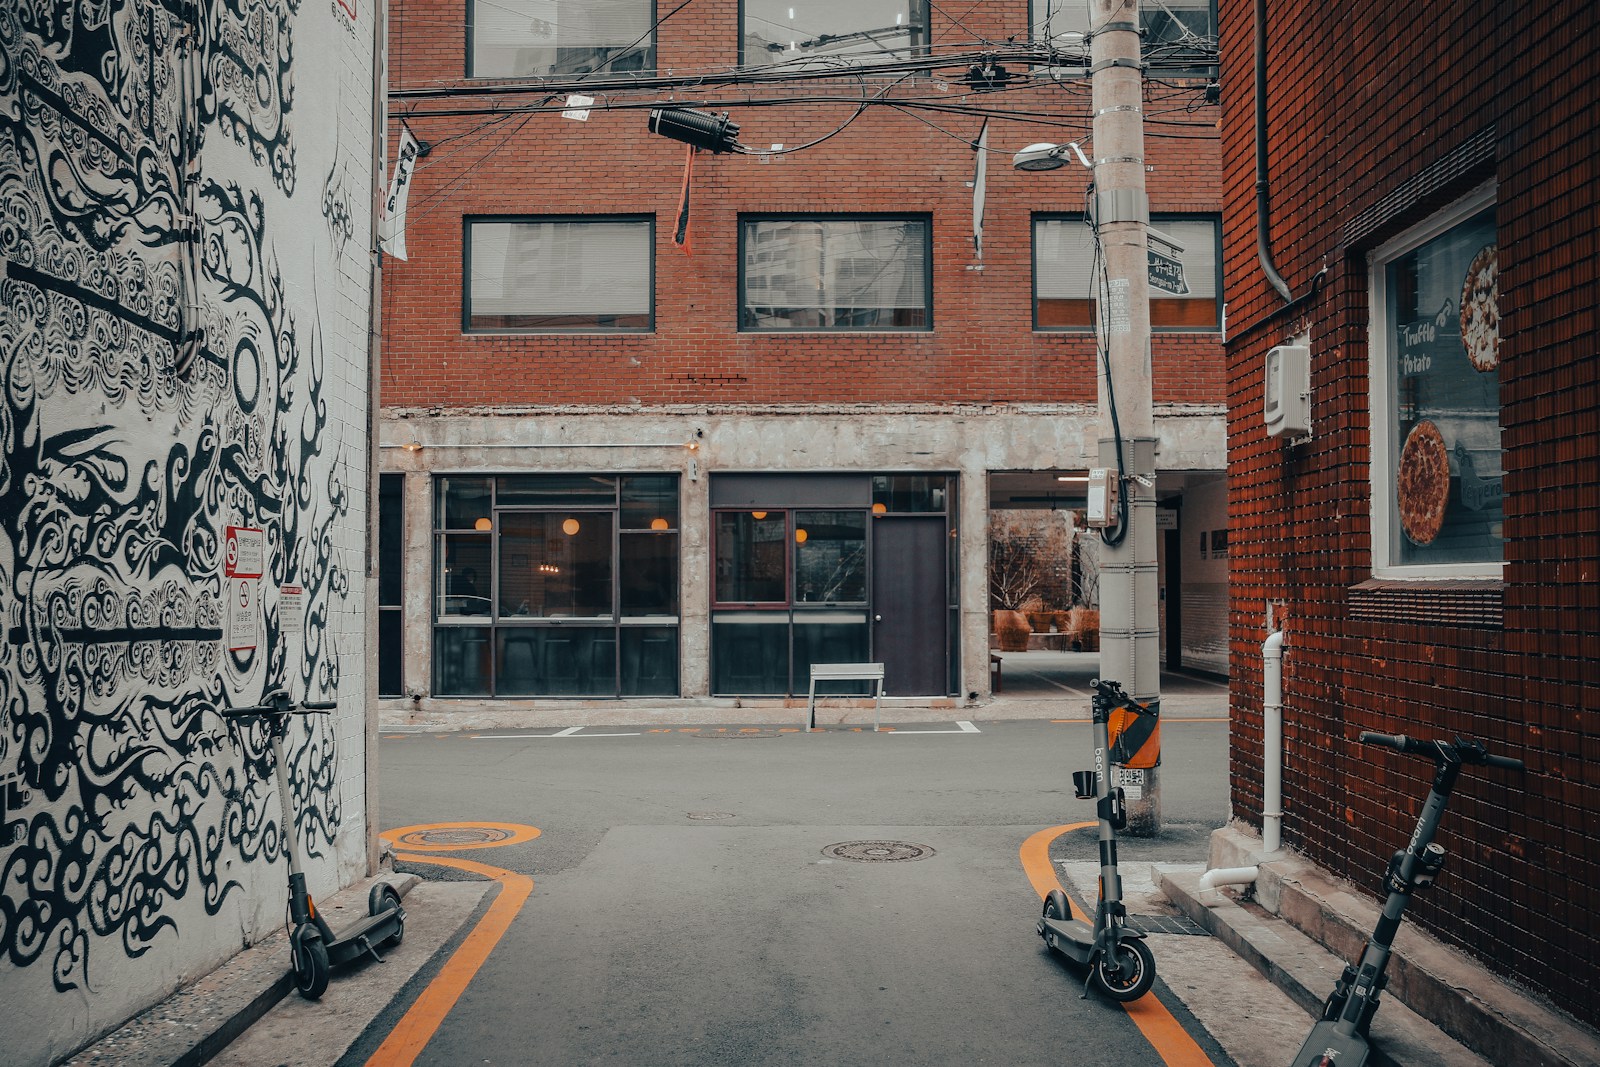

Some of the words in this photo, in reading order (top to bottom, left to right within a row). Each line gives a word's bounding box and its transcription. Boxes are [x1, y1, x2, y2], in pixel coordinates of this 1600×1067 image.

[1403, 322, 1435, 347] Truffle
[1404, 353, 1431, 375] Potato
[1094, 747, 1104, 783] beam
